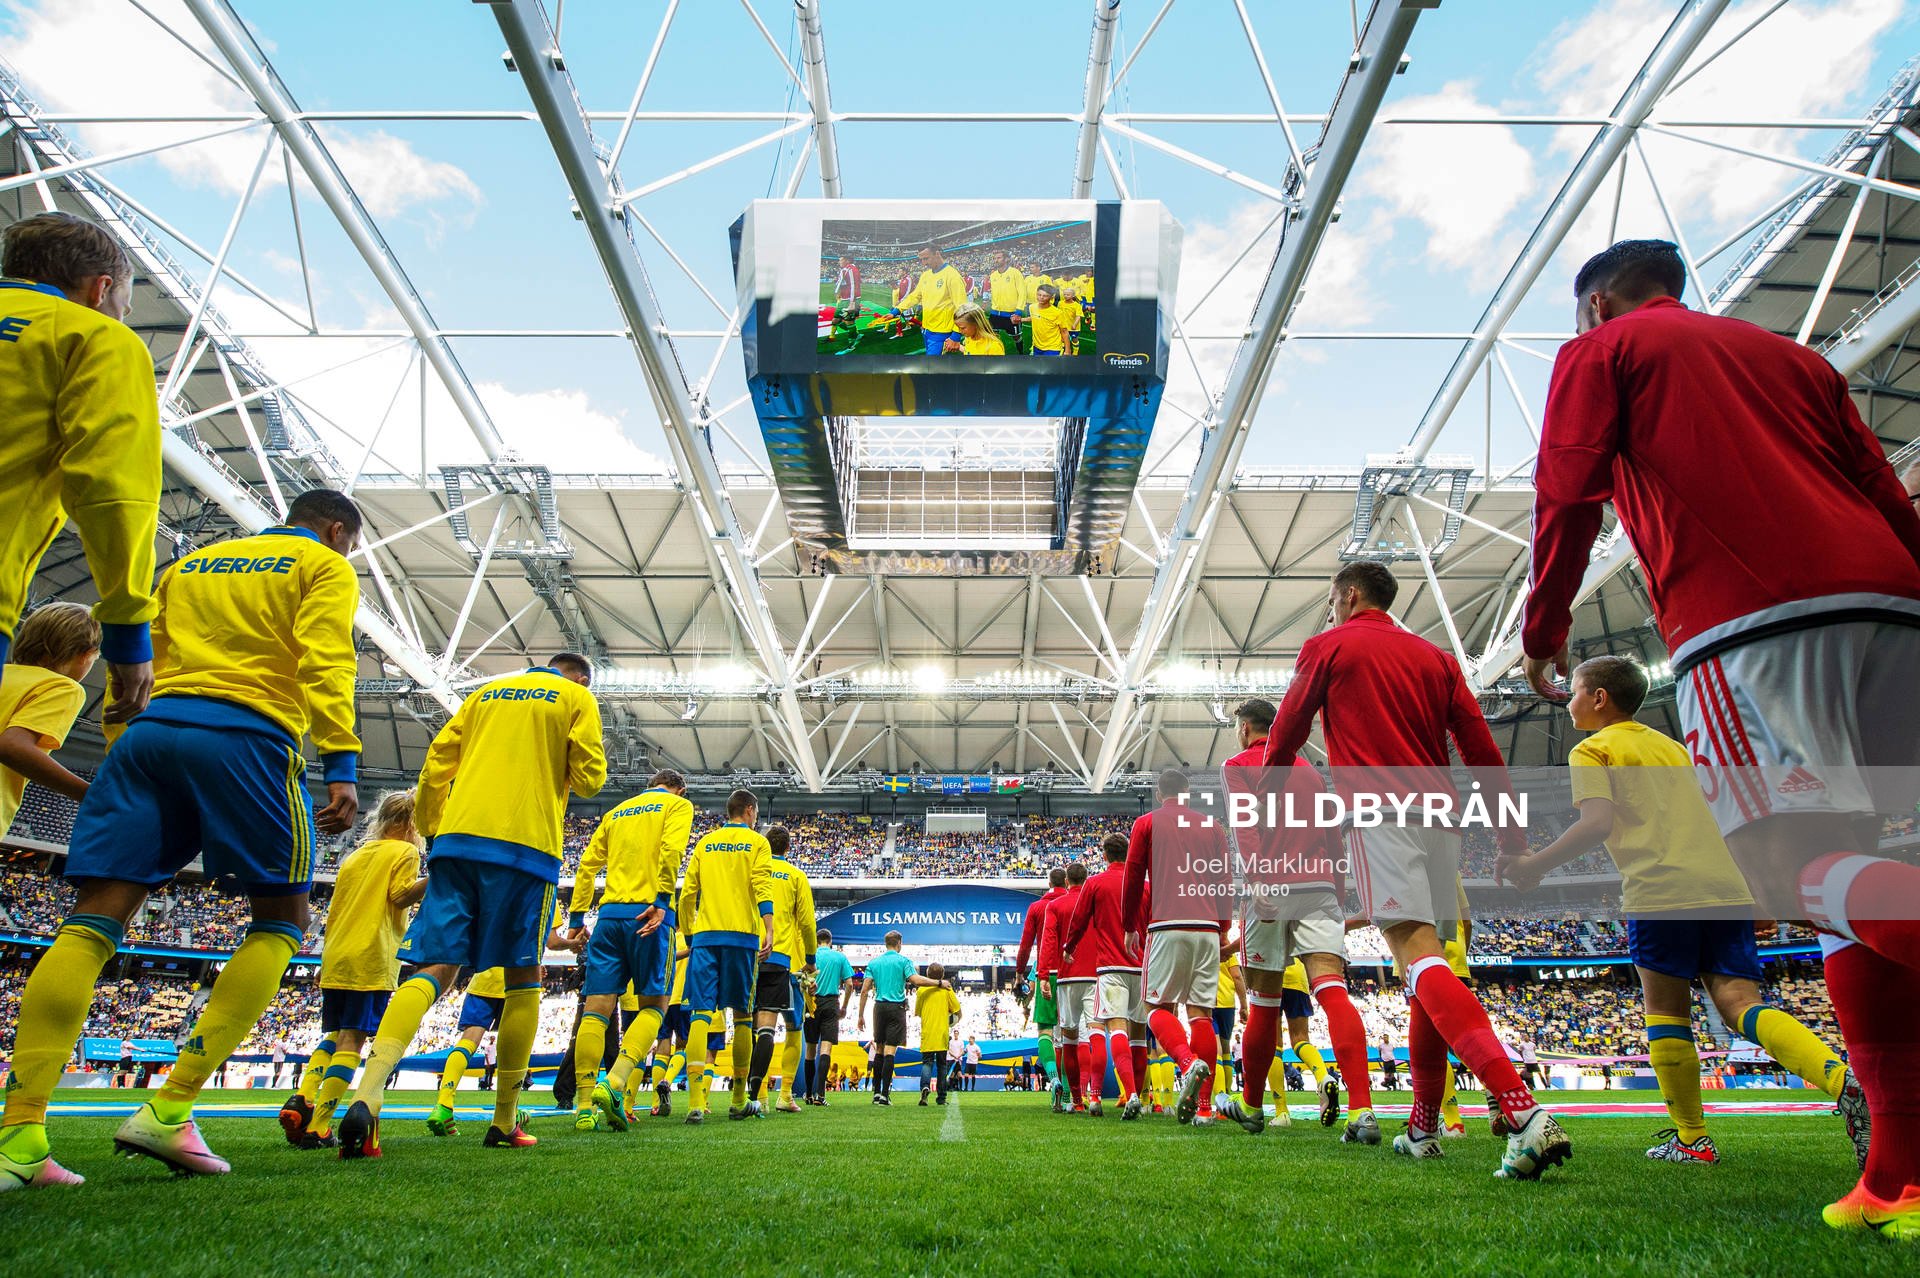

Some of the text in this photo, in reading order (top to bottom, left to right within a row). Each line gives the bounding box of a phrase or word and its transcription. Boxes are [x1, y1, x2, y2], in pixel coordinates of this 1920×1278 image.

[1109, 356, 1143, 366] friends
[179, 556, 297, 574] SVERIGE
[480, 687, 560, 704] SVERIGE
[612, 803, 664, 820] SVERIGE
[704, 842, 753, 853] SVERIGE
[852, 911, 1021, 925] TILLSAMMANS TAR VI
